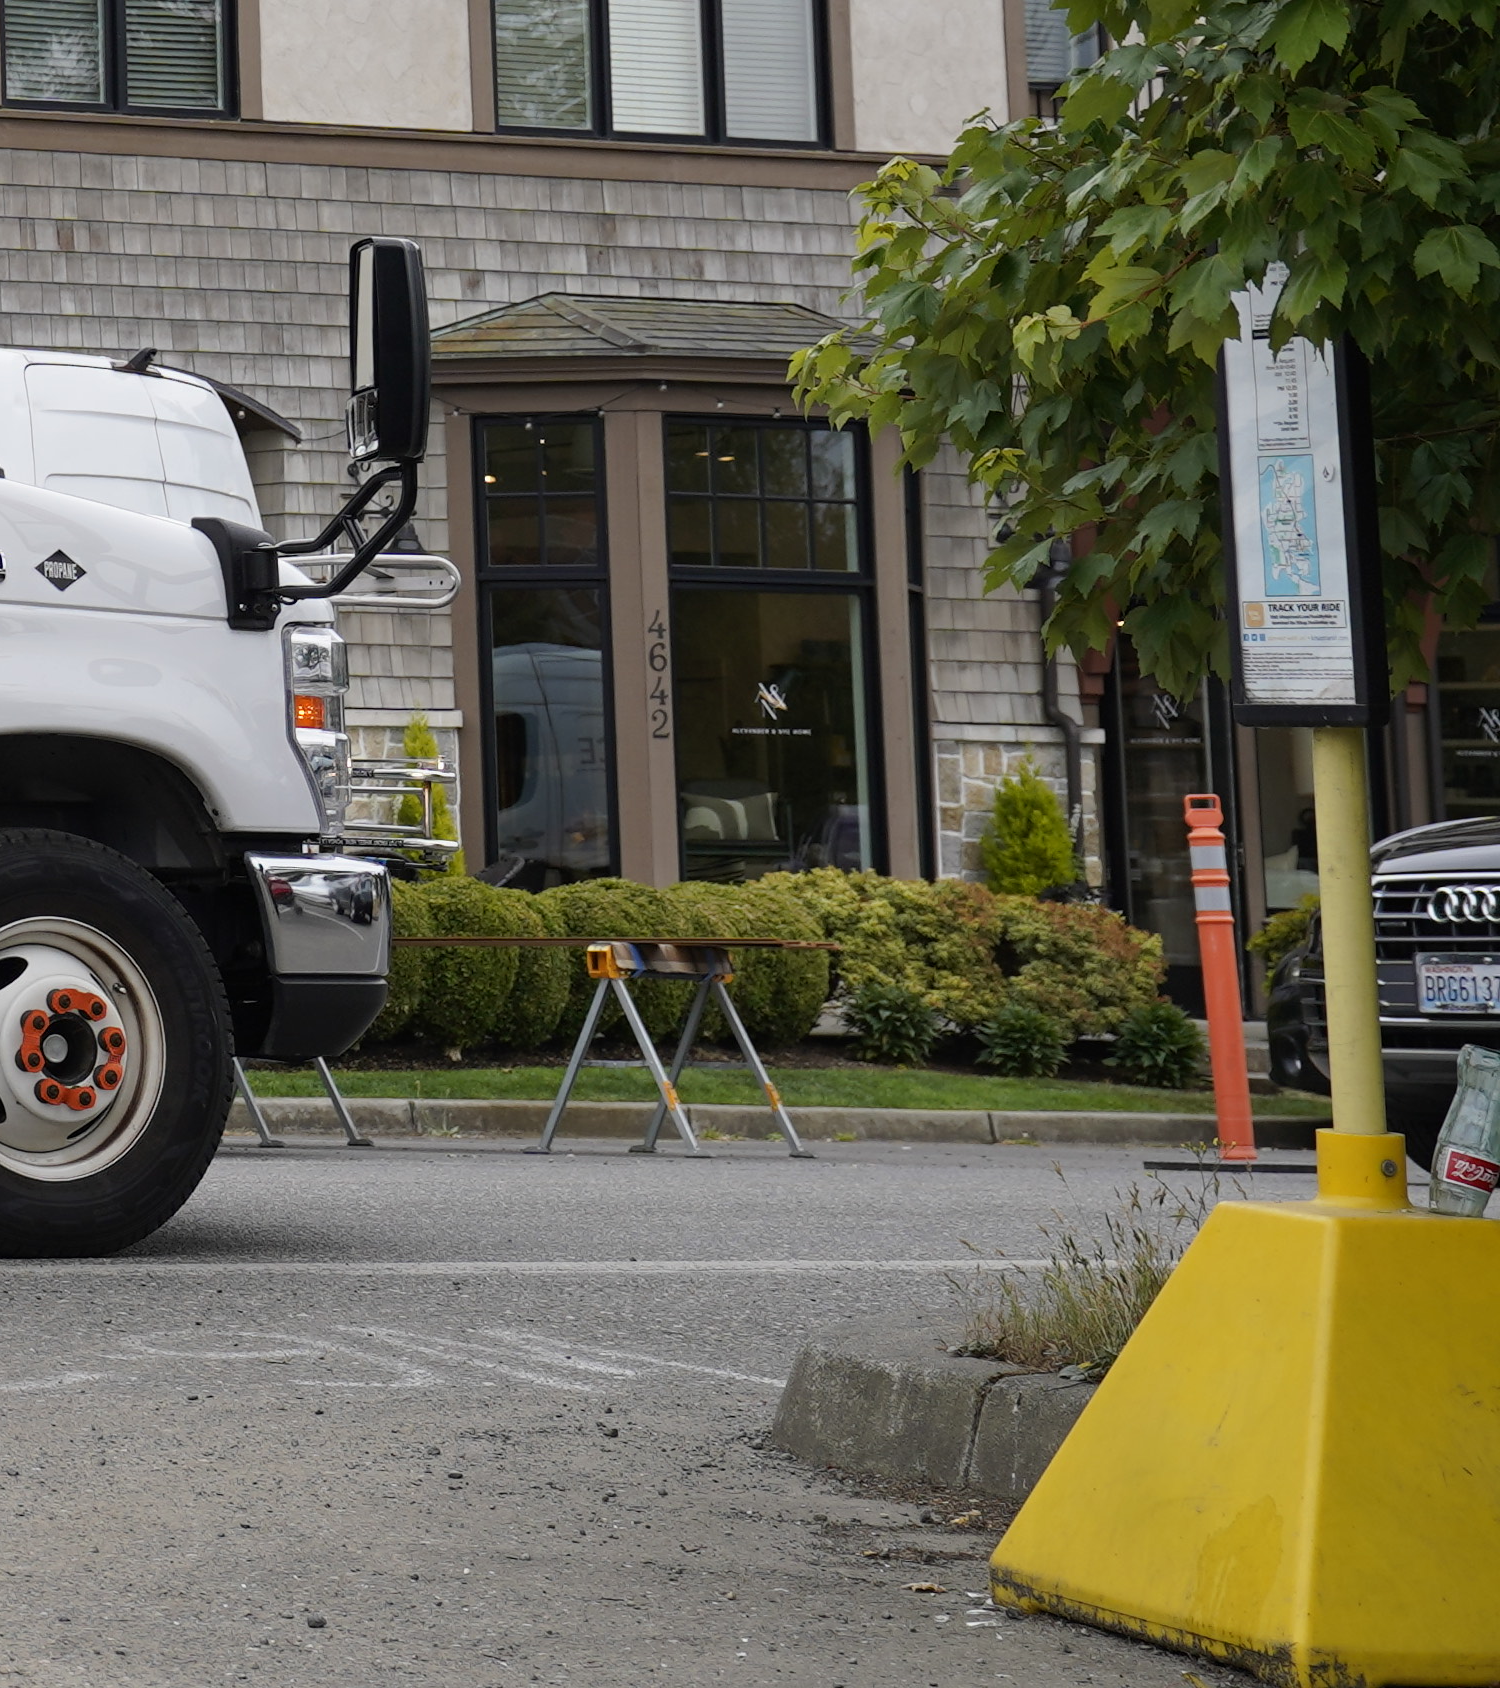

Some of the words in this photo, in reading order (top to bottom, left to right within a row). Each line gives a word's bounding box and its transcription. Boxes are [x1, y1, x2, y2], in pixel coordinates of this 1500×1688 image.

[43, 560, 79, 581] PROPANE
[1268, 603, 1294, 612] TRACK
[1297, 603, 1319, 612] YOUR
[1321, 603, 1341, 612] RIDE
[648, 610, 670, 740] 4642
[1424, 965, 1474, 974] WASHINGTON
